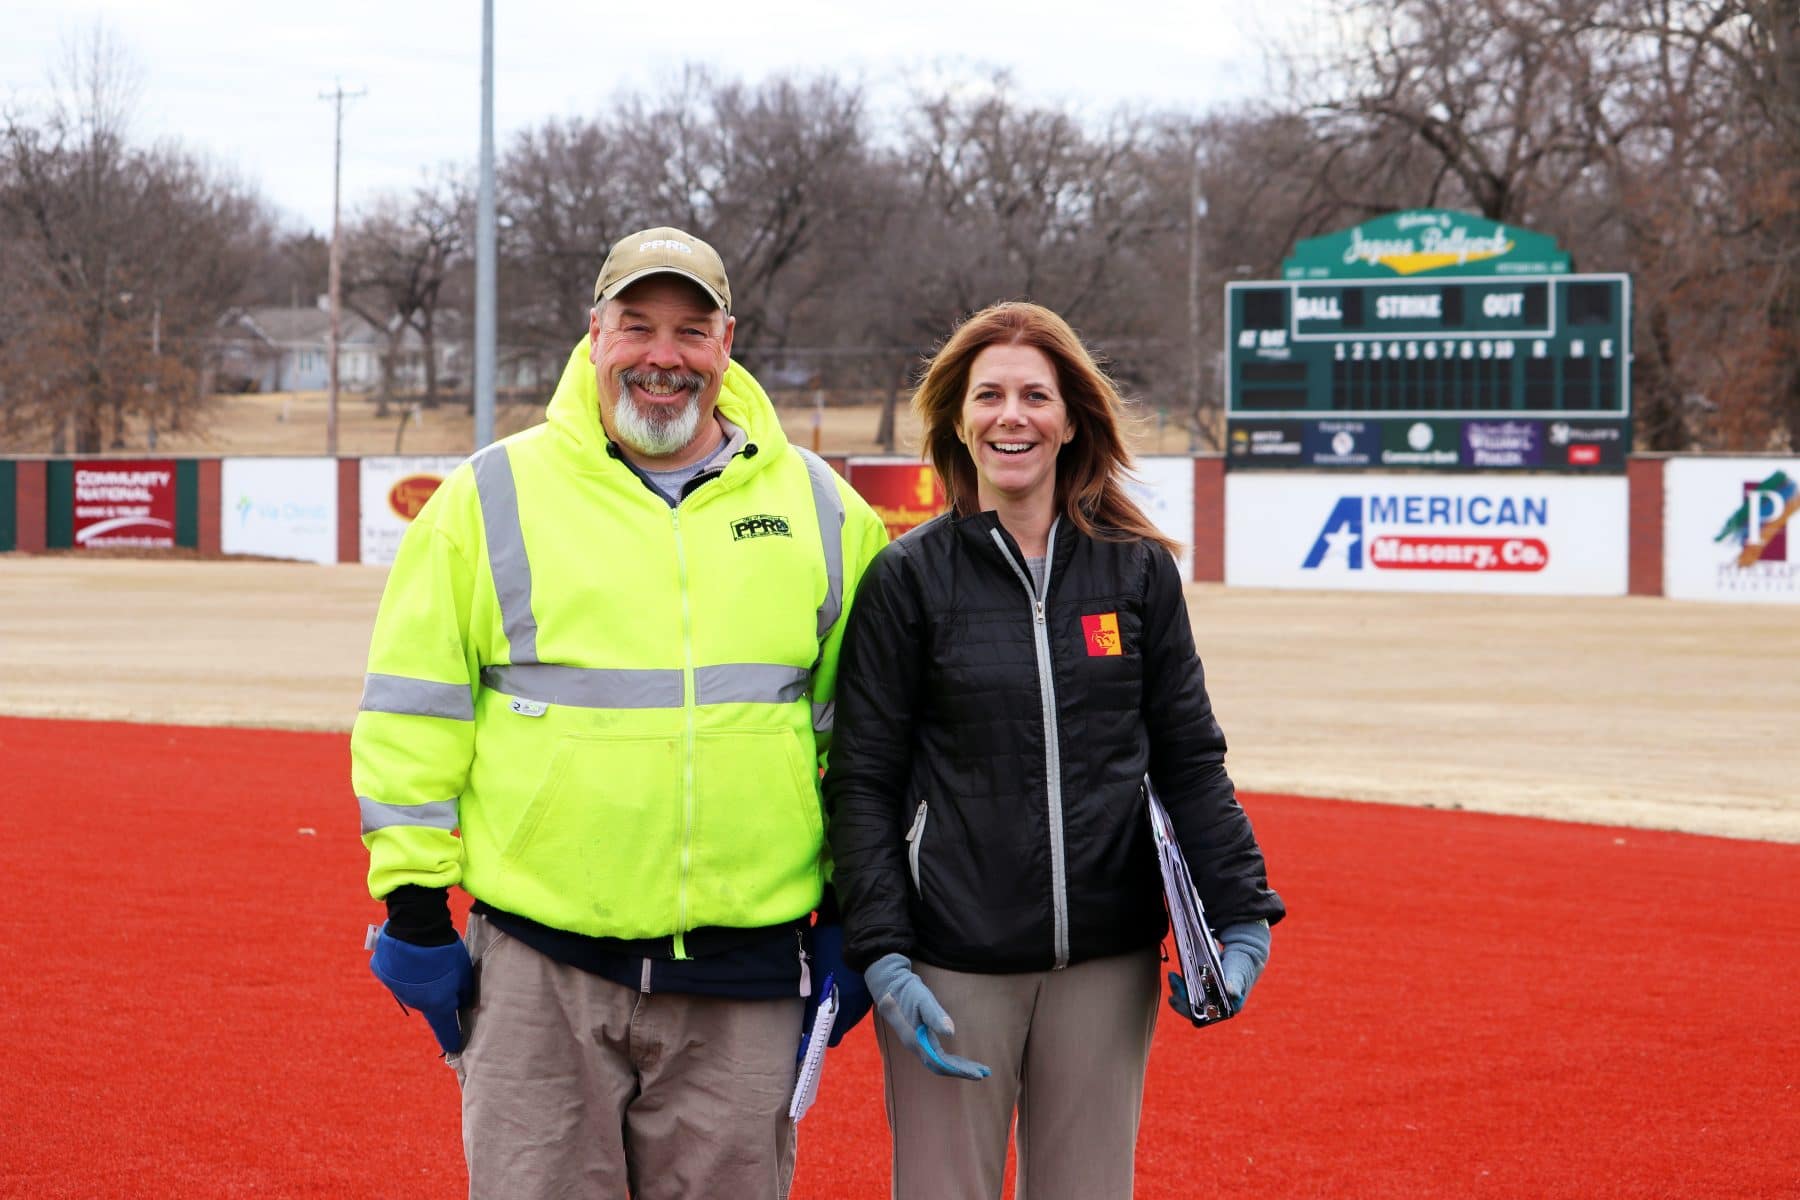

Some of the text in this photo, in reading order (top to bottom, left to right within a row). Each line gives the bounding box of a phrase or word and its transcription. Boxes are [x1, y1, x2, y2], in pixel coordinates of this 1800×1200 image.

[1296, 297, 1343, 319] BALL
[1377, 295, 1441, 319] STRIKE
[1483, 293, 1524, 317] OUT
[1335, 341, 1345, 360] 1
[1352, 341, 1364, 360] 2
[1370, 341, 1382, 360] 3
[1388, 341, 1400, 360] 4
[1406, 341, 1418, 360] 5
[1424, 341, 1437, 360] 6
[1443, 341, 1455, 359] 7
[1461, 341, 1473, 359] 8
[1480, 341, 1493, 359] 9
[1495, 340, 1515, 359] 10
[76, 470, 169, 487] COMMUNITY
[76, 486, 152, 501] NATIONAL
[1747, 489, 1786, 545] P
[1373, 537, 1545, 568] Masonry, Co.
